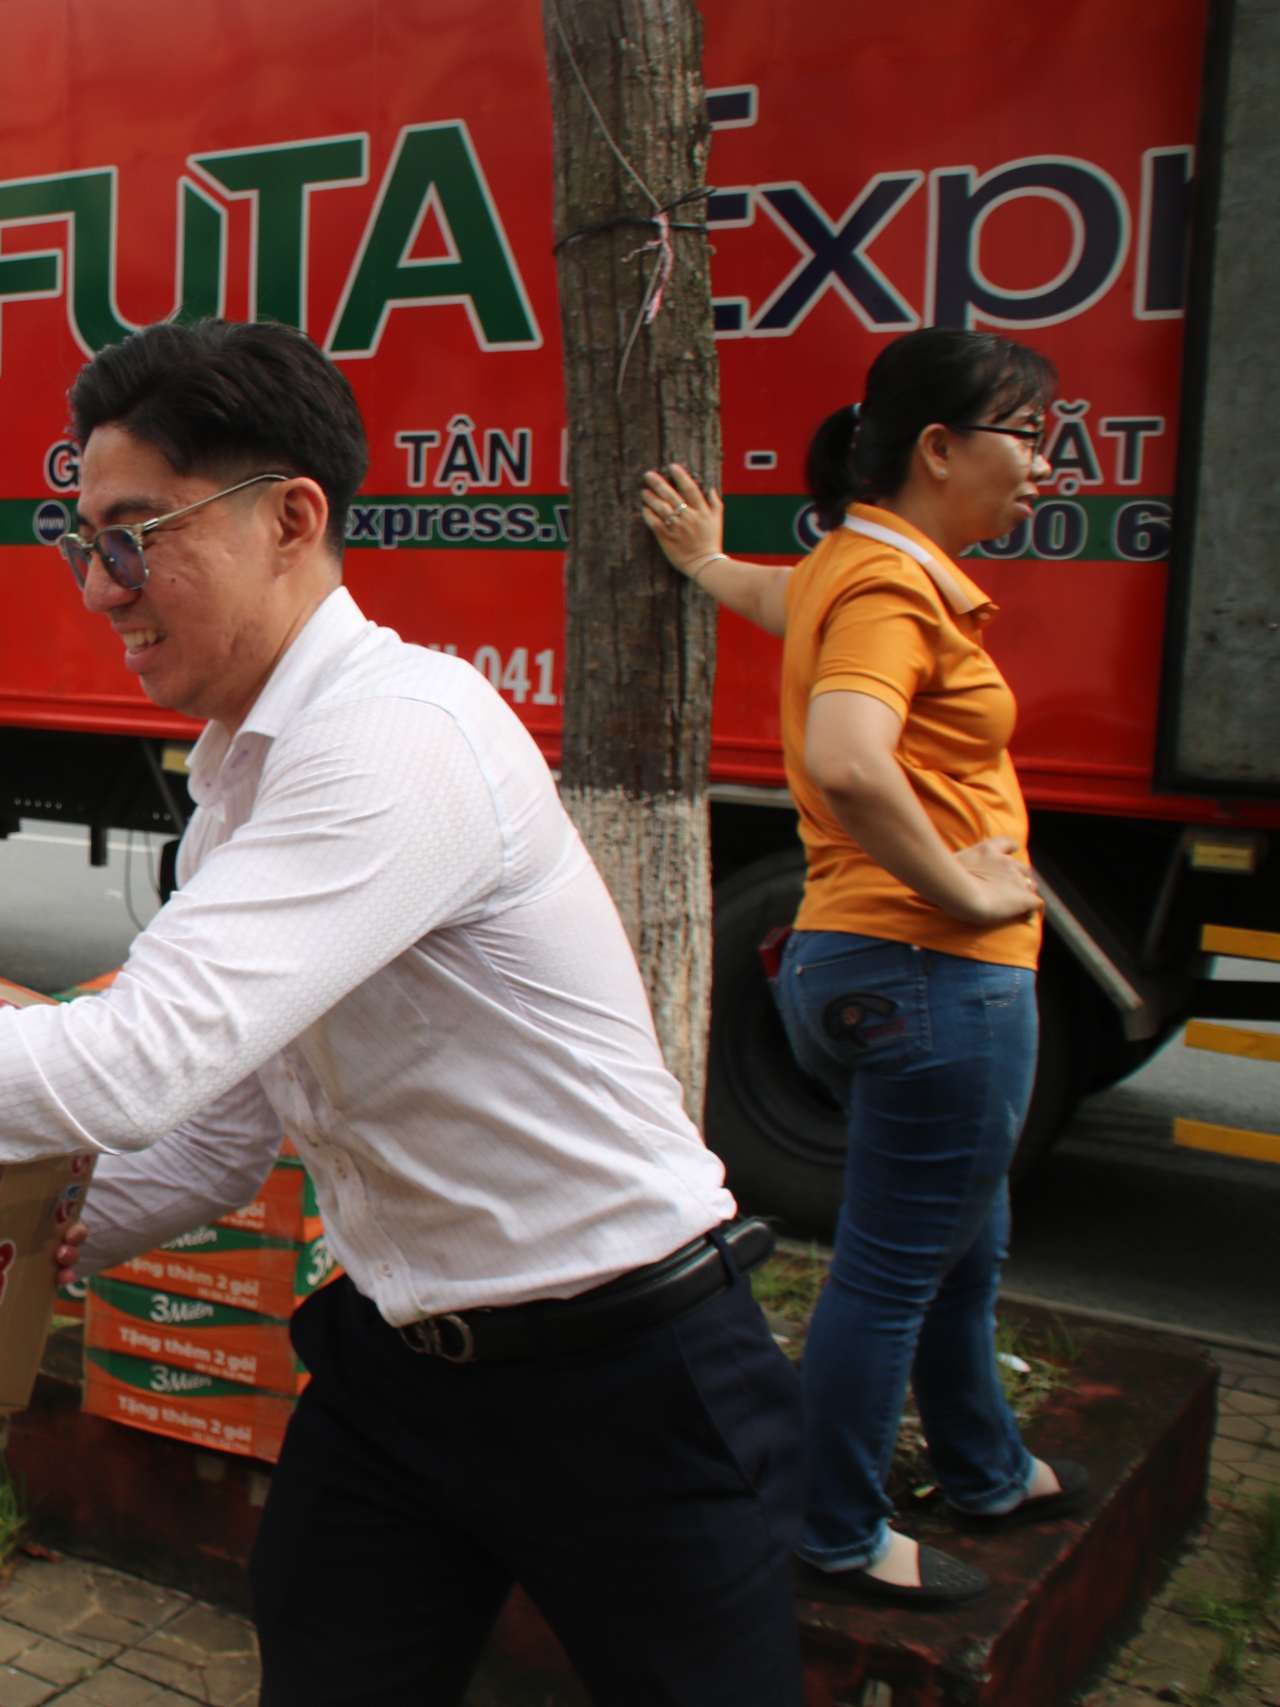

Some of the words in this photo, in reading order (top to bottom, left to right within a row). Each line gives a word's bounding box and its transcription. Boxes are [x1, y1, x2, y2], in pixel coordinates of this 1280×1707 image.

[396, 414, 532, 496] TẬN
[1037, 398, 1165, 496] ẶT
[344, 503, 570, 549] xpress.
[123, 1257, 163, 1278] ặng
